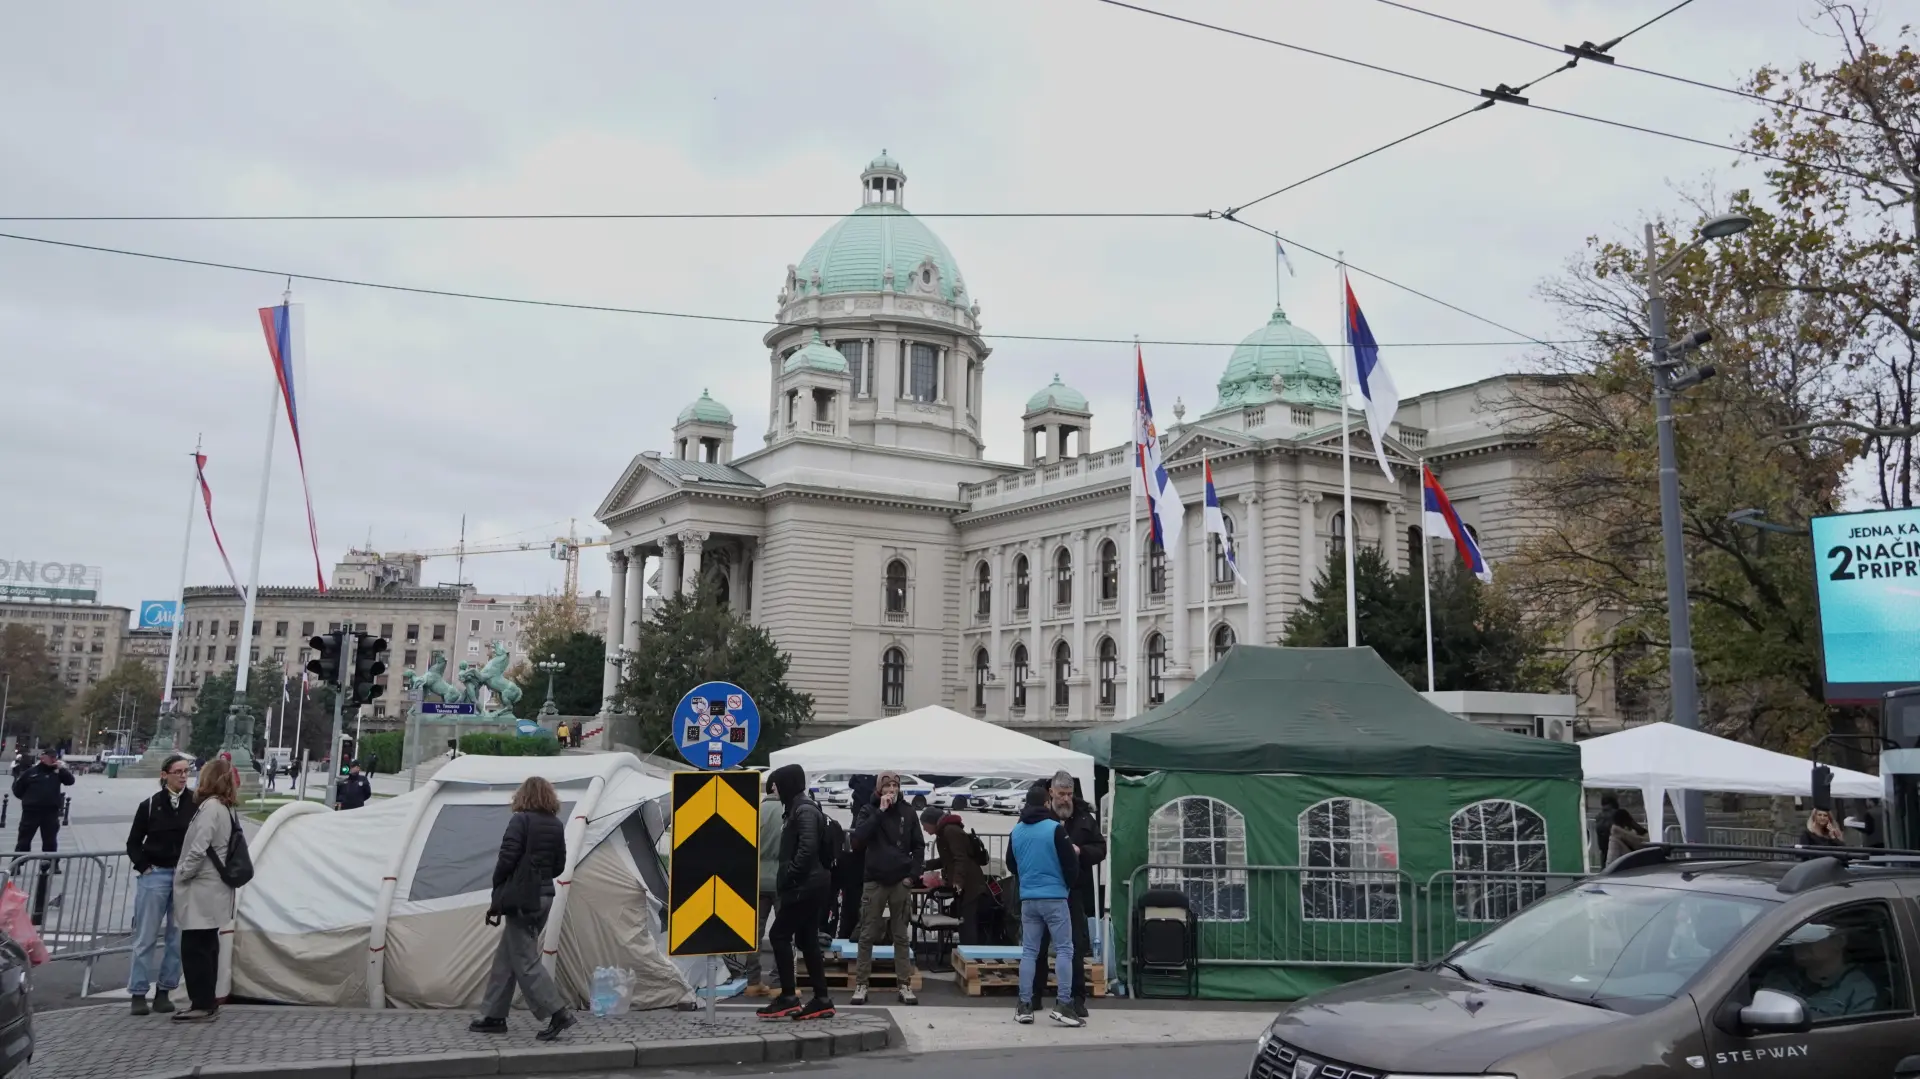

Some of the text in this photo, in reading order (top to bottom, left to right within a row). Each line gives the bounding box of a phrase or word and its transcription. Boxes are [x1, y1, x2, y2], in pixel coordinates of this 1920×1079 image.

[1848, 525, 1893, 539] JEDNA
[1827, 545, 1856, 581] 2
[1858, 560, 1920, 579] PRIPR
[1716, 1045, 1808, 1064] STEPWAY
